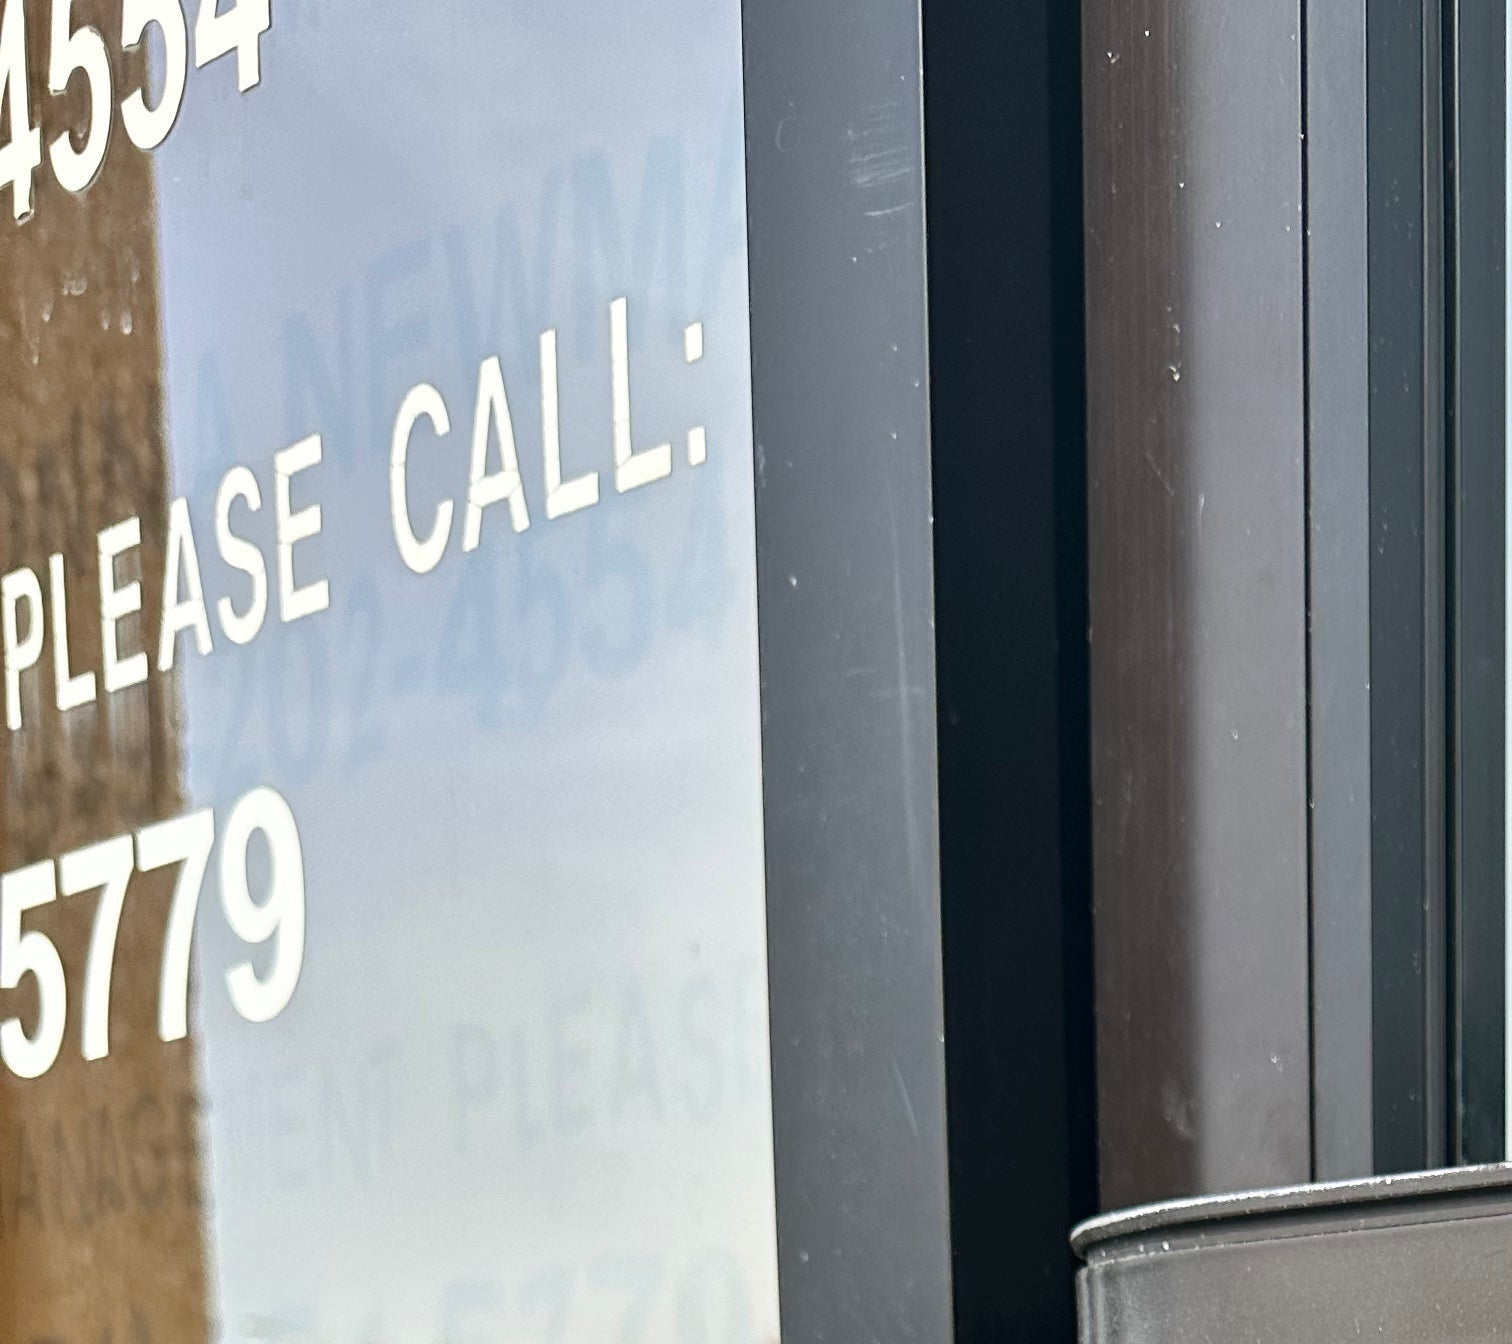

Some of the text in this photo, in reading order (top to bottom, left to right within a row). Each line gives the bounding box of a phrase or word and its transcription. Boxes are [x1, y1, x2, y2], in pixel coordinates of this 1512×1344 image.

[3, 297, 706, 730] PLEASE CALL:
[0, 786, 305, 1079] 5779
